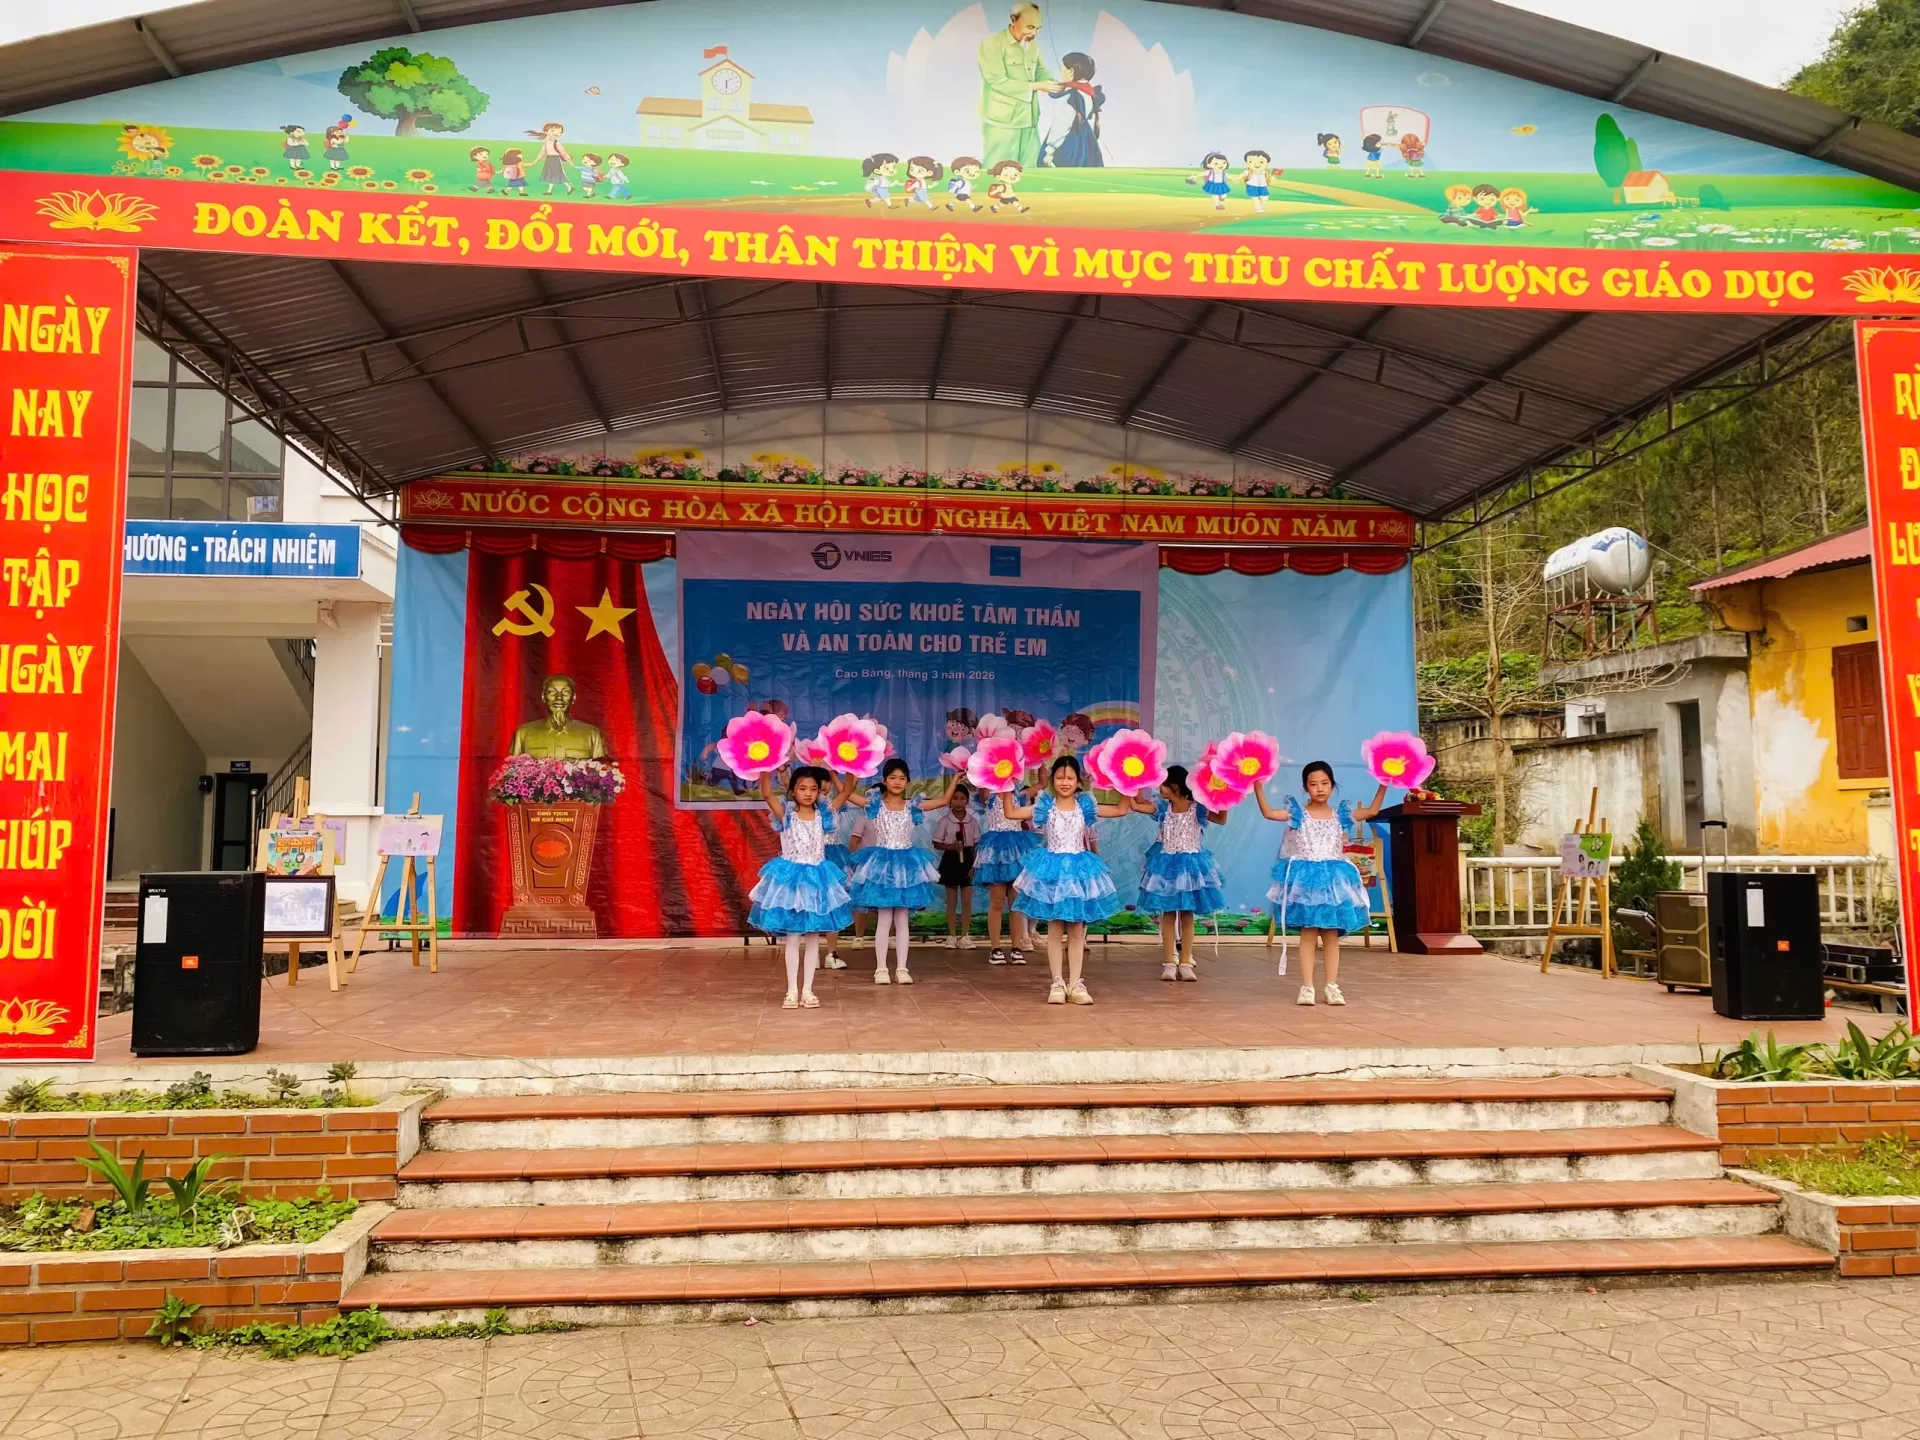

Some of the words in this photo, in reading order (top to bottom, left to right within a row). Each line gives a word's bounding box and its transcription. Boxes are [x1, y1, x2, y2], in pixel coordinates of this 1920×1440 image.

[193, 198, 344, 242] ĐOÀN
[358, 201, 470, 256] KẾT,
[485, 203, 573, 254] ĐỔI
[587, 217, 690, 267] MỚI,
[704, 224, 839, 268] THÂN
[853, 233, 996, 281] THIỆN
[1010, 238, 1060, 276] VÌ
[1074, 247, 1172, 289] MỤC
[1184, 246, 1291, 285] TIÊU
[1303, 247, 1425, 291] CHẤT
[1438, 260, 1590, 303] LƯỢNG
[1603, 261, 1711, 299] GIÁO
[1724, 268, 1815, 307] DỤC
[2, 294, 111, 354] NGÀY
[11, 388, 93, 437] NAY
[2, 473, 89, 533] HỌC
[460, 488, 550, 514] NƯỚC
[561, 492, 651, 520] CỘNG
[662, 495, 730, 521] HÒA
[739, 498, 783, 523] XÃ
[794, 496, 850, 528] HỘI
[860, 498, 922, 527] CHỦ
[934, 506, 1031, 530] NGHĨA
[1040, 506, 1110, 534] VIỆT
[1122, 514, 1185, 534] NAM
[1196, 510, 1282, 536] MUÔN
[1291, 514, 1357, 538] NĂM
[203, 530, 266, 563] TRÁCH
[272, 532, 336, 569] NHIỆM
[844, 550, 892, 562] VNIES
[4, 548, 80, 619] TẬP
[747, 599, 806, 621] NGÀY
[815, 599, 850, 624] HỘI
[859, 599, 902, 622] SỨC
[972, 603, 1017, 625] TÂM
[1024, 603, 1081, 627] THẦN
[782, 629, 810, 651] VÀ
[818, 633, 849, 652] AN
[856, 630, 913, 652] TOÀN
[920, 634, 962, 653] CHO
[969, 631, 1007, 655] TRẺ
[1015, 638, 1047, 656] EM
[835, 669, 858, 679] Cao
[932, 670, 939, 679] 3
[969, 671, 995, 680] 2026
[0, 732, 68, 781] MAI
[0, 807, 72, 869] IÚP
